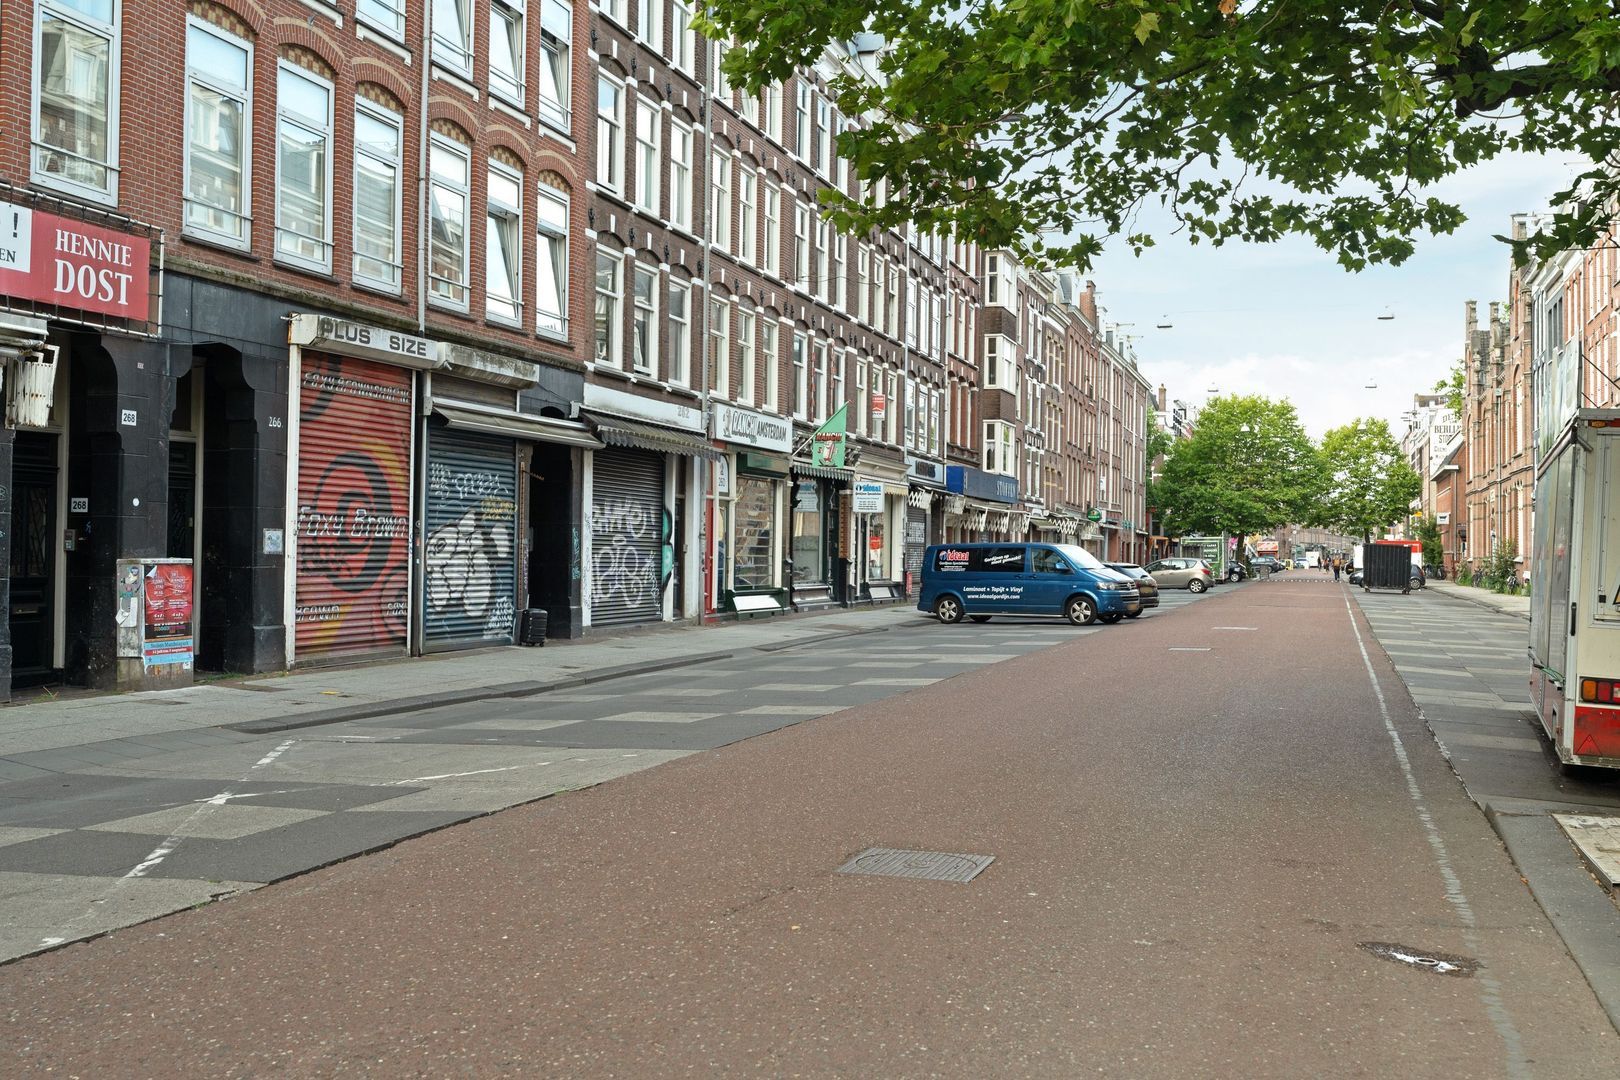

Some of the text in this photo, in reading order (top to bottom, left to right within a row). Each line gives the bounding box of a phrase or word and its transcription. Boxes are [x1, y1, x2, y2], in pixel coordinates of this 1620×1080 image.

[55, 228, 132, 267] HENNIE
[53, 258, 133, 306] DOST
[320, 318, 427, 357] PLUS SIZE
[123, 412, 136, 423] 268
[268, 416, 282, 428] 266
[757, 420, 787, 442] AMSTERDAM
[72, 500, 87, 510] 268
